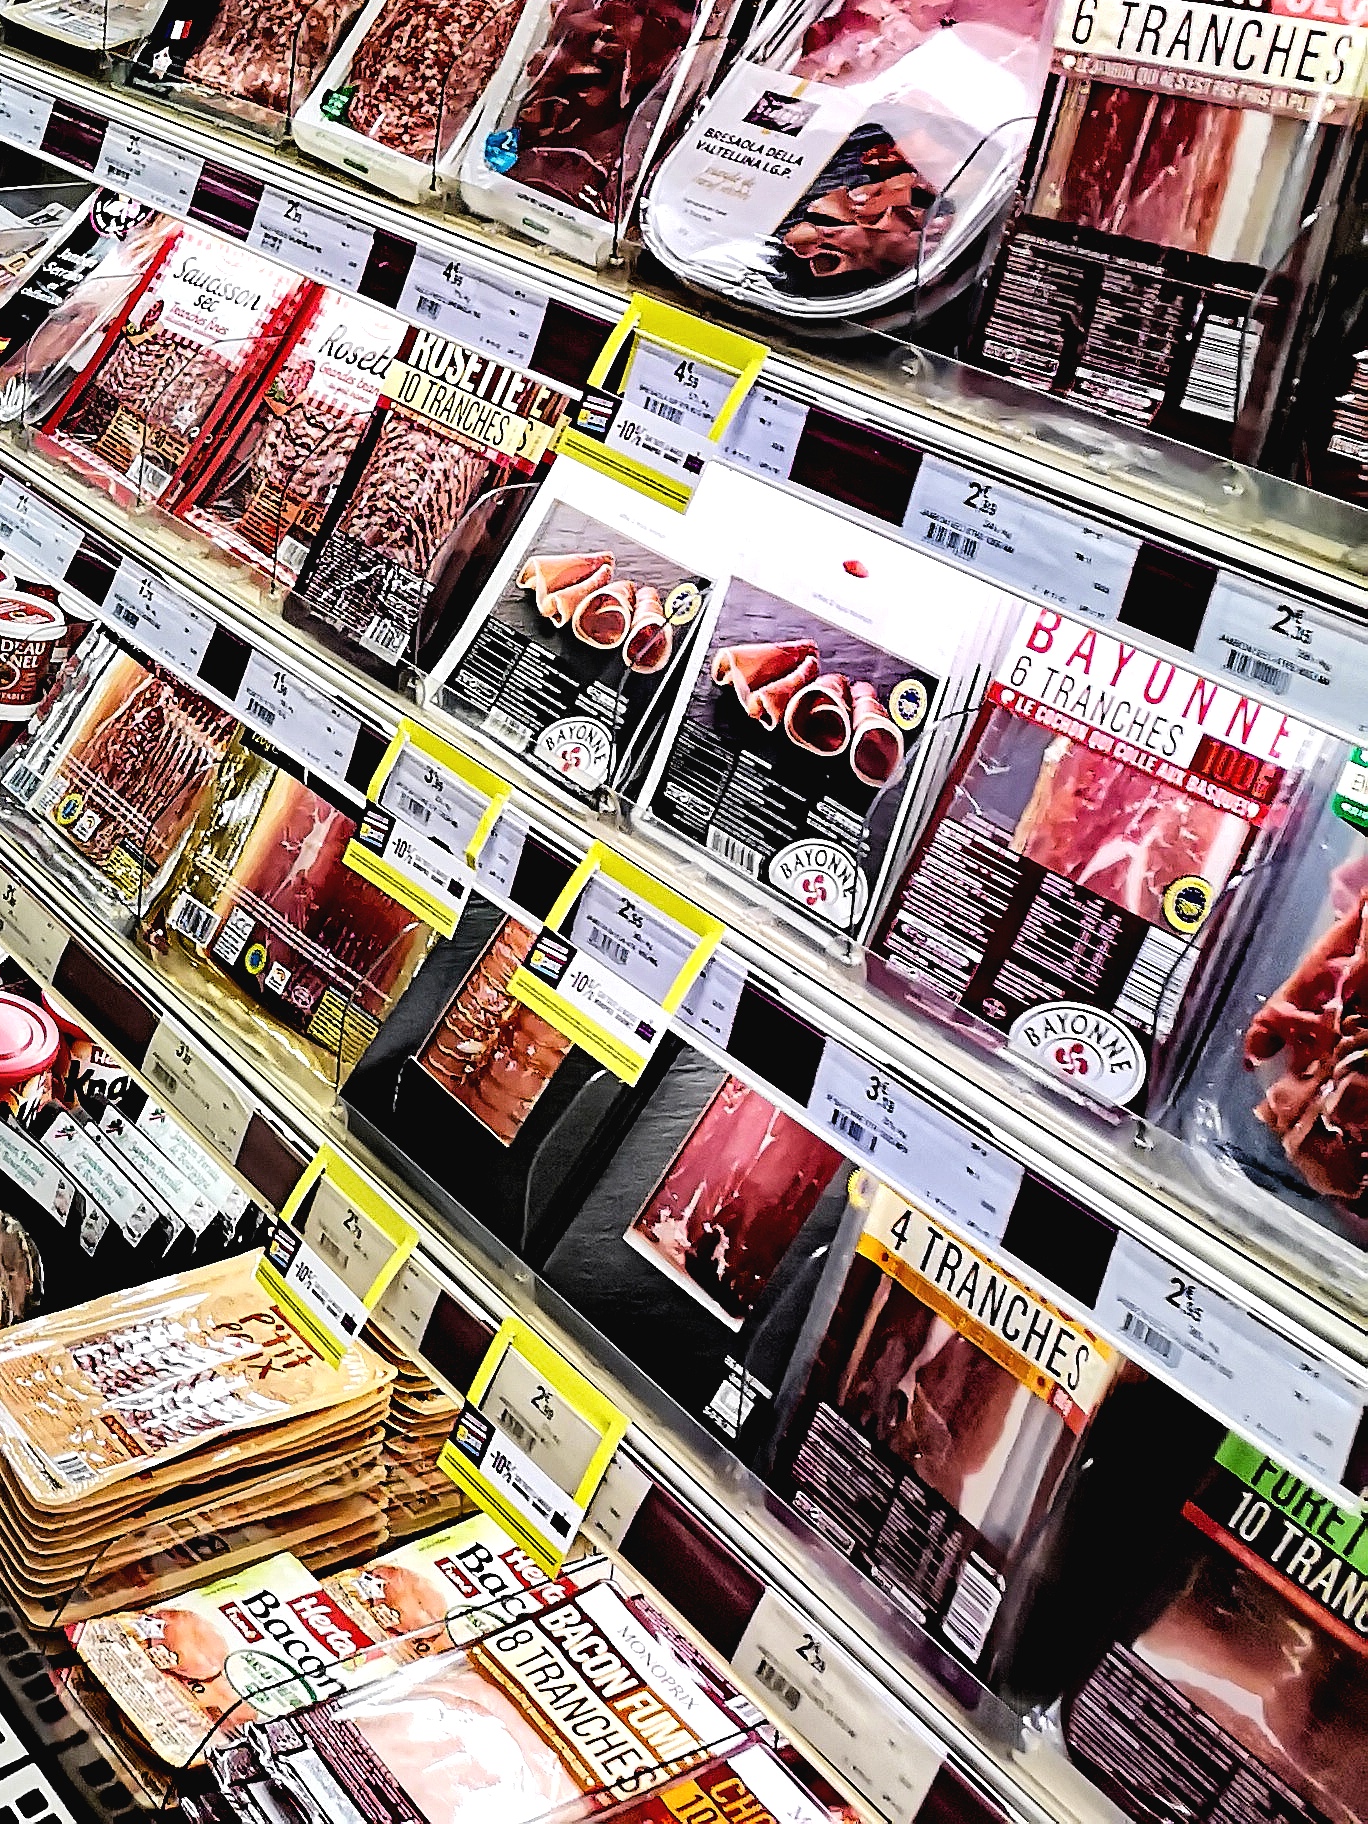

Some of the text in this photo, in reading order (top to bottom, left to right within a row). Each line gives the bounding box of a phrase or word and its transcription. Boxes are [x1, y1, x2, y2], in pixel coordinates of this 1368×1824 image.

[1117, 1, 1352, 85] TRANCHES
[696, 140, 761, 171] VALTELLINA
[704, 127, 804, 166] BRESAOLA DELLA
[173, 256, 262, 313] Saucisson
[193, 291, 218, 313] sec
[400, 369, 417, 402] 10
[422, 380, 509, 446] TRANCHES
[1010, 656, 1183, 756] 6 TRANCHES
[1015, 695, 1035, 716] LE
[1026, 607, 1290, 758] BAYONNE
[1024, 1013, 1132, 1073] BAYONNE
[890, 1208, 910, 1252] 4
[914, 1226, 1090, 1393] TRANCHES
[1228, 1491, 1259, 1543] 10
[457, 1542, 527, 1623] Bac
[242, 1589, 346, 1694] Bacon
[294, 1592, 358, 1659] Herta
[544, 1607, 635, 1697] BACON
[616, 1626, 696, 1711] MONOPRIX
[496, 1629, 660, 1796] 8 TRANCHES
